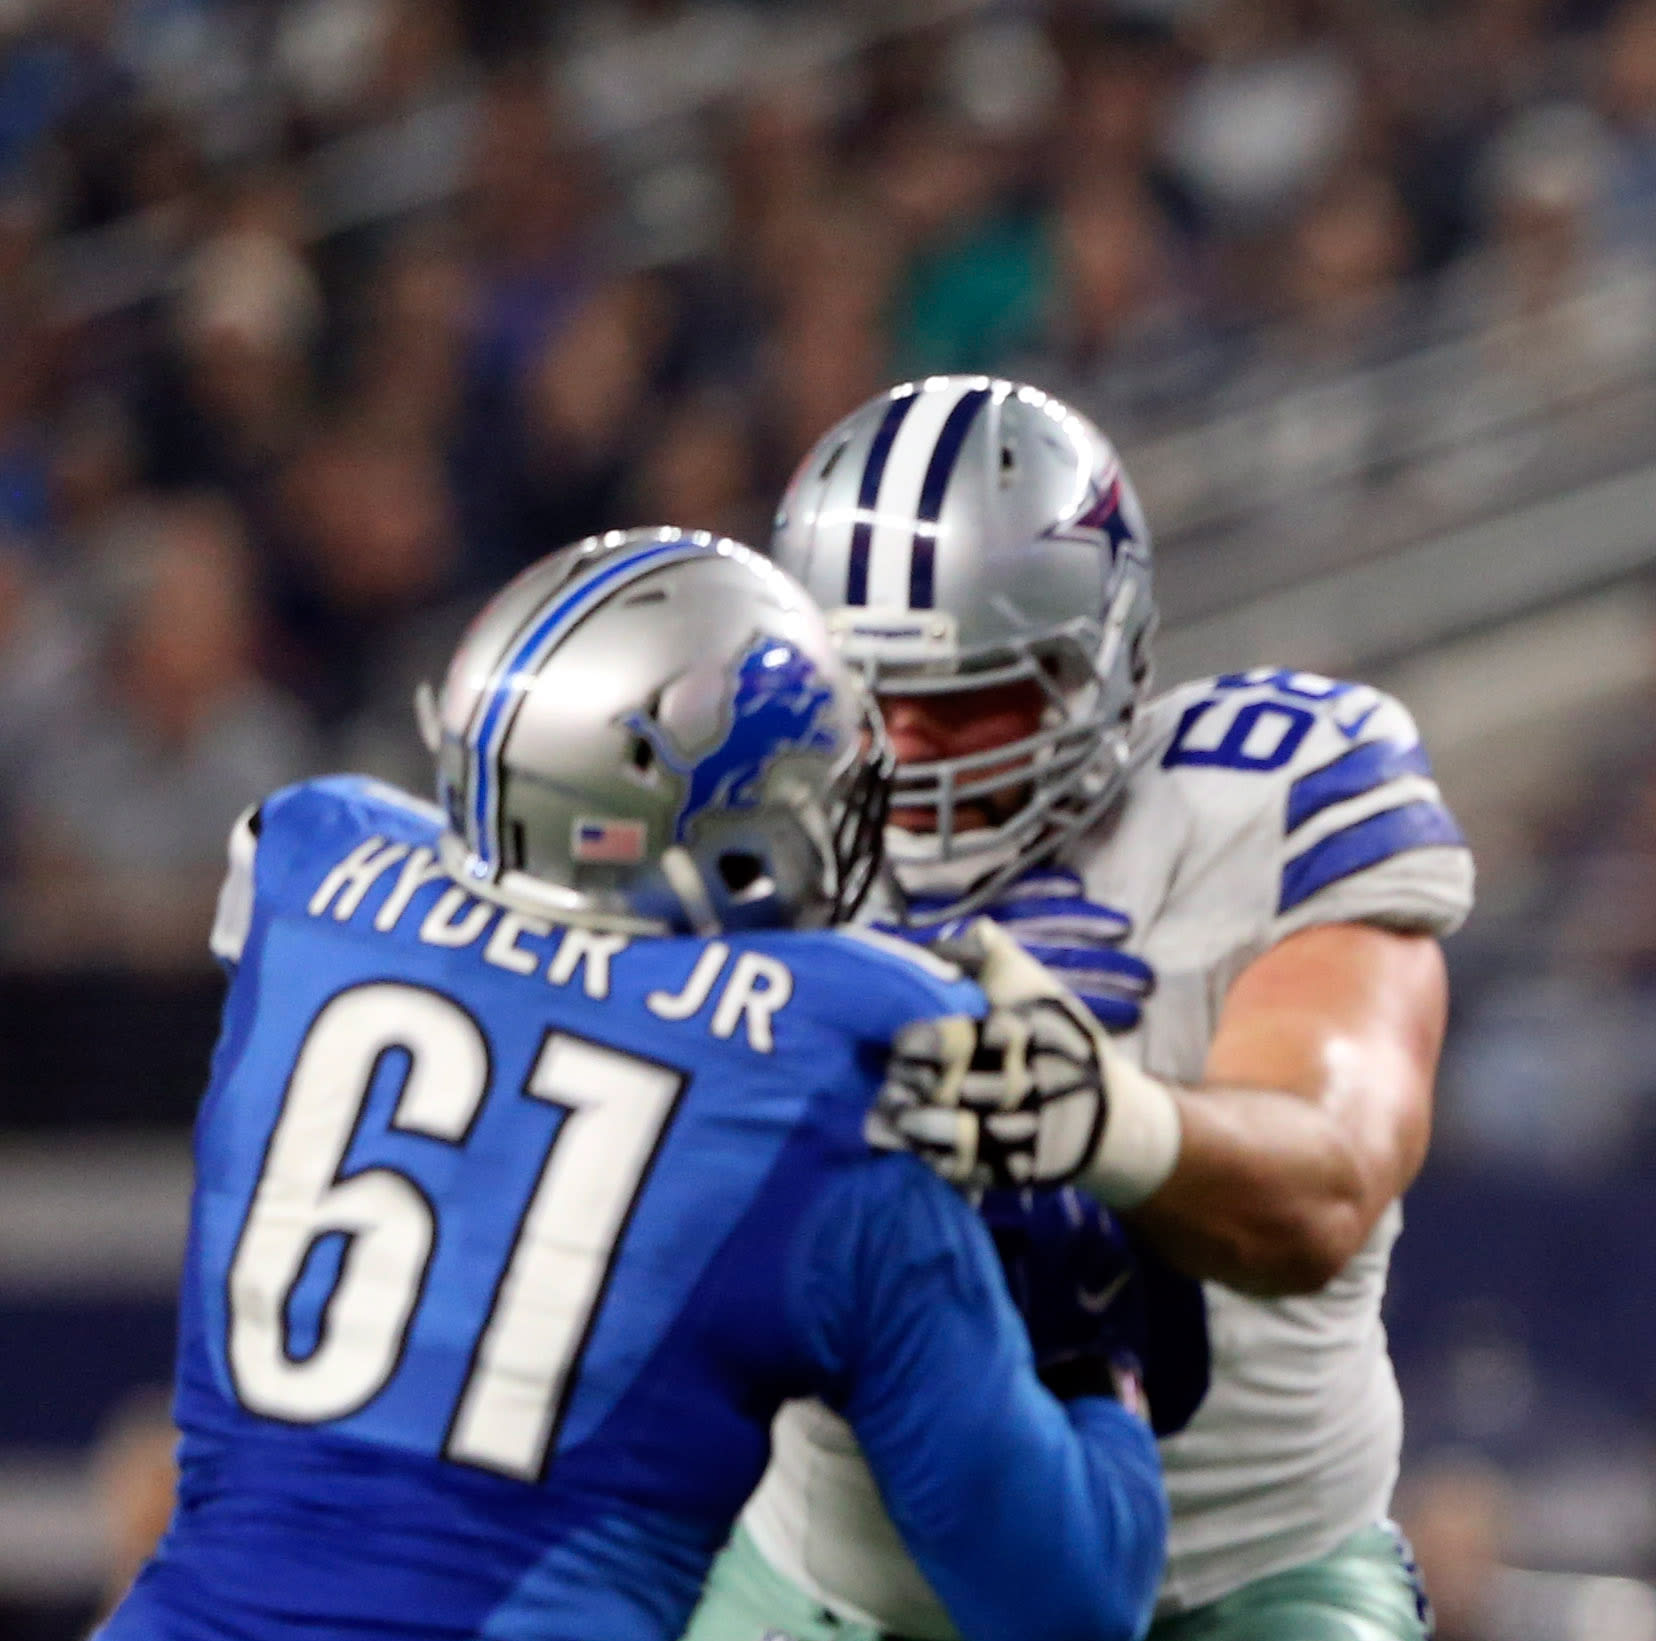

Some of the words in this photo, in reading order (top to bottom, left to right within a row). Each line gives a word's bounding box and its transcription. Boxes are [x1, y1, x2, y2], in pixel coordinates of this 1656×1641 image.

[307, 834, 632, 1000] HYDER
[645, 941, 794, 1054] JR
[226, 978, 694, 1485] 61
